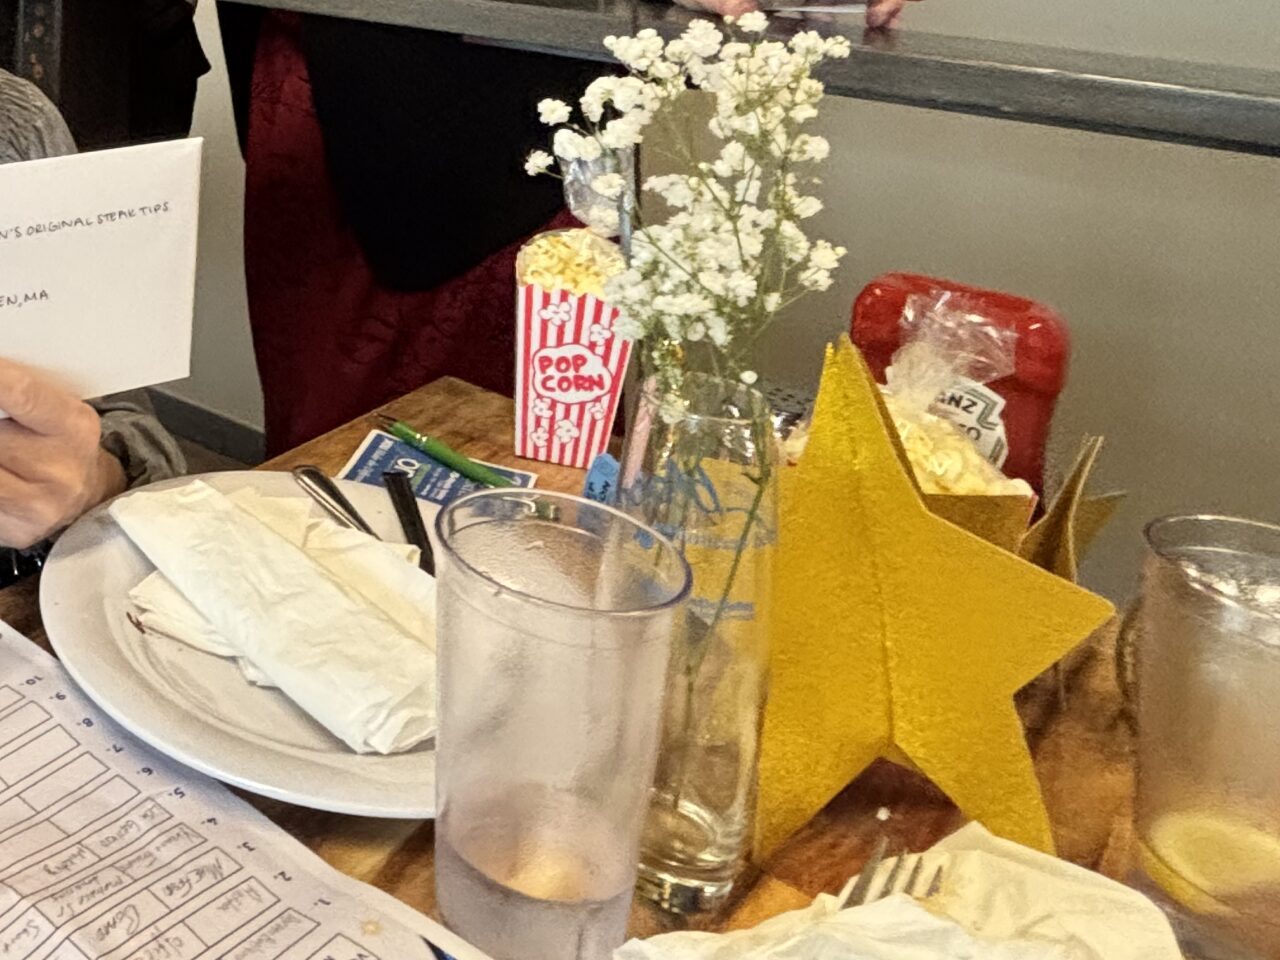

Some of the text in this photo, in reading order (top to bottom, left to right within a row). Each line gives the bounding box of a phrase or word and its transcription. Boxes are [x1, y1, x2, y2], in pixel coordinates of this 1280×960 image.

[26, 216, 93, 236] ORIGINAL
[97, 208, 136, 225] STEAK
[138, 201, 169, 214] TIPS
[538, 354, 588, 375] POP
[541, 373, 605, 393] CORN
